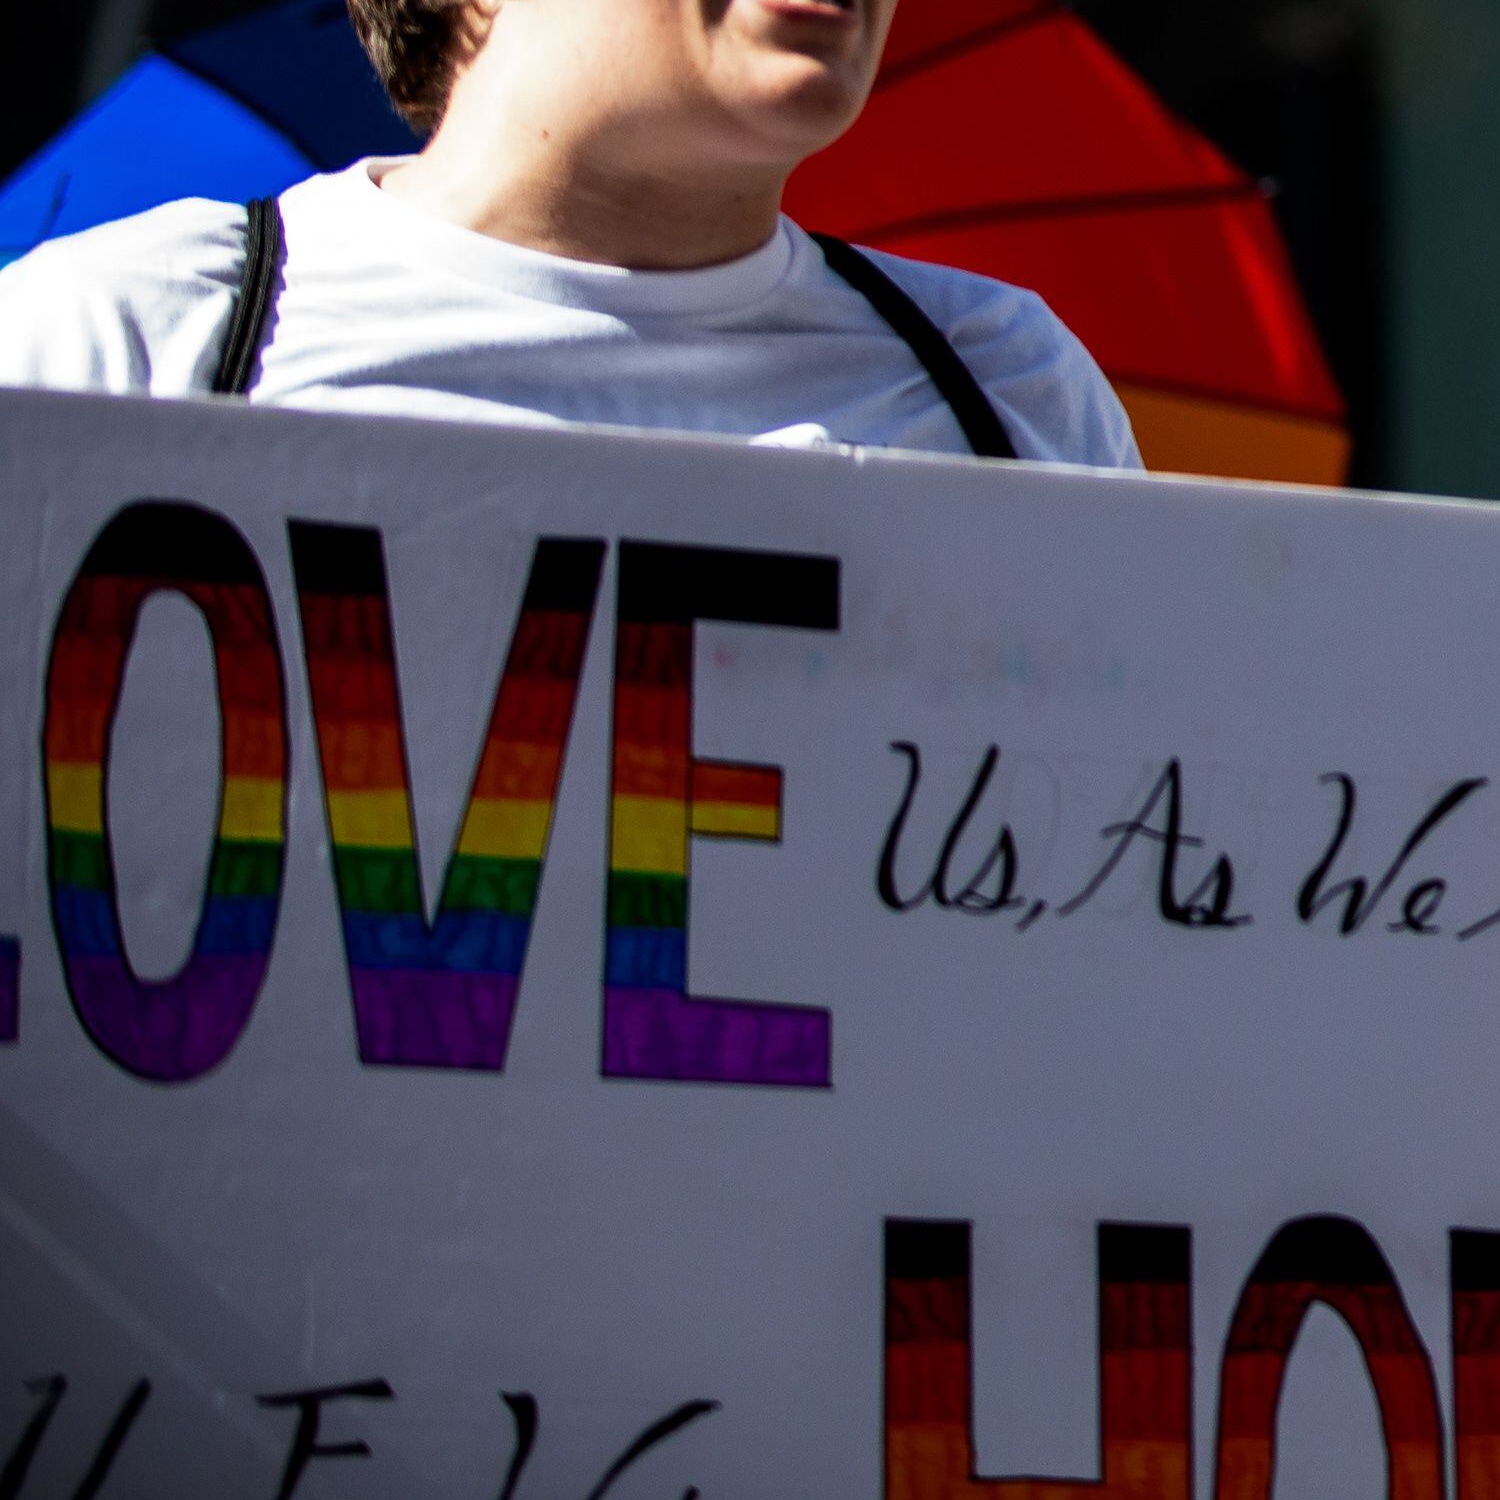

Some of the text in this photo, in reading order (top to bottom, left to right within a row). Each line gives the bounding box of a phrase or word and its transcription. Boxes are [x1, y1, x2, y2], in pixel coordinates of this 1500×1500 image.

[0, 497, 842, 1092] OVE
[1058, 757, 1253, 928] As
[1295, 772, 1490, 937] We
